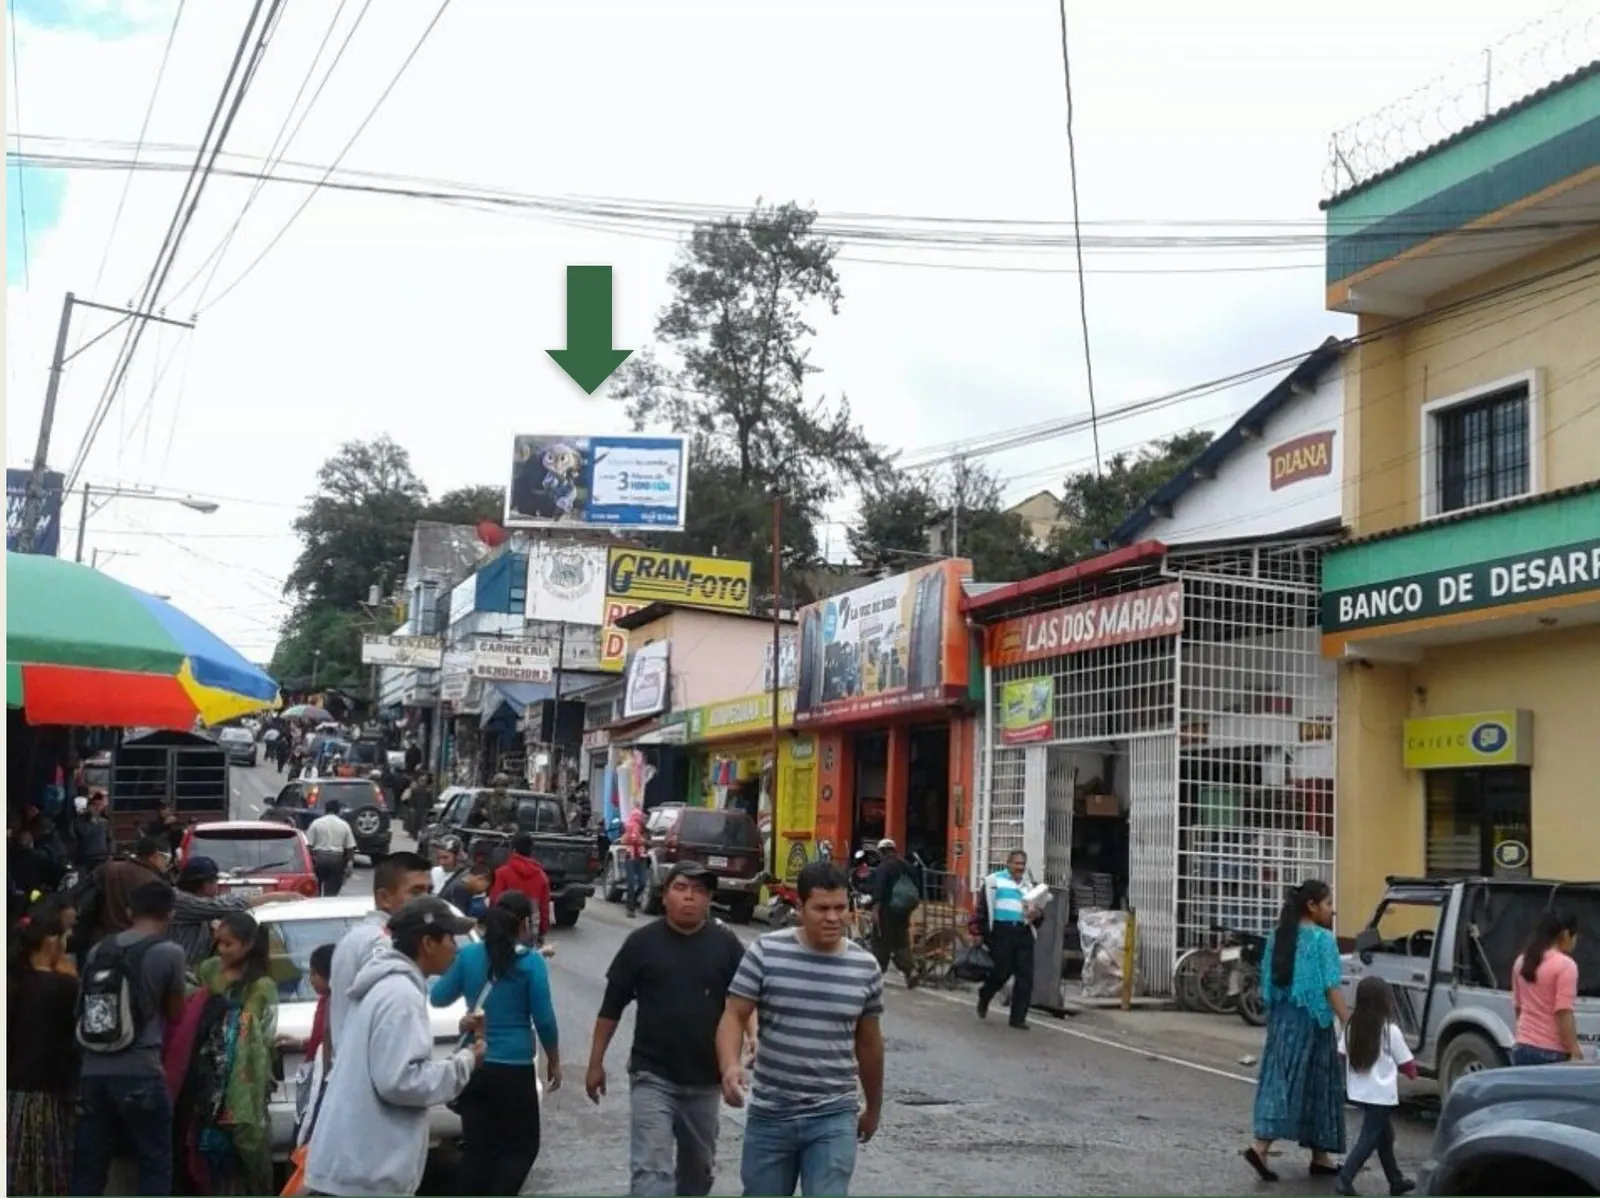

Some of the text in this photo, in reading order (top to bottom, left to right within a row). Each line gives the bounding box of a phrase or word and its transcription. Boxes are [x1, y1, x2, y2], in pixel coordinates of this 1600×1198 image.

[1275, 442, 1327, 479] DIANA
[617, 471, 629, 491] 3
[611, 554, 691, 593] GRAN
[685, 573, 747, 600] FOTO
[1339, 583, 1423, 623] BANCO
[1438, 573, 1474, 606] DE
[1027, 618, 1058, 651] LAS
[1061, 608, 1096, 646] DOS
[1098, 591, 1180, 638] MARIAS
[506, 655, 521, 665] LA
